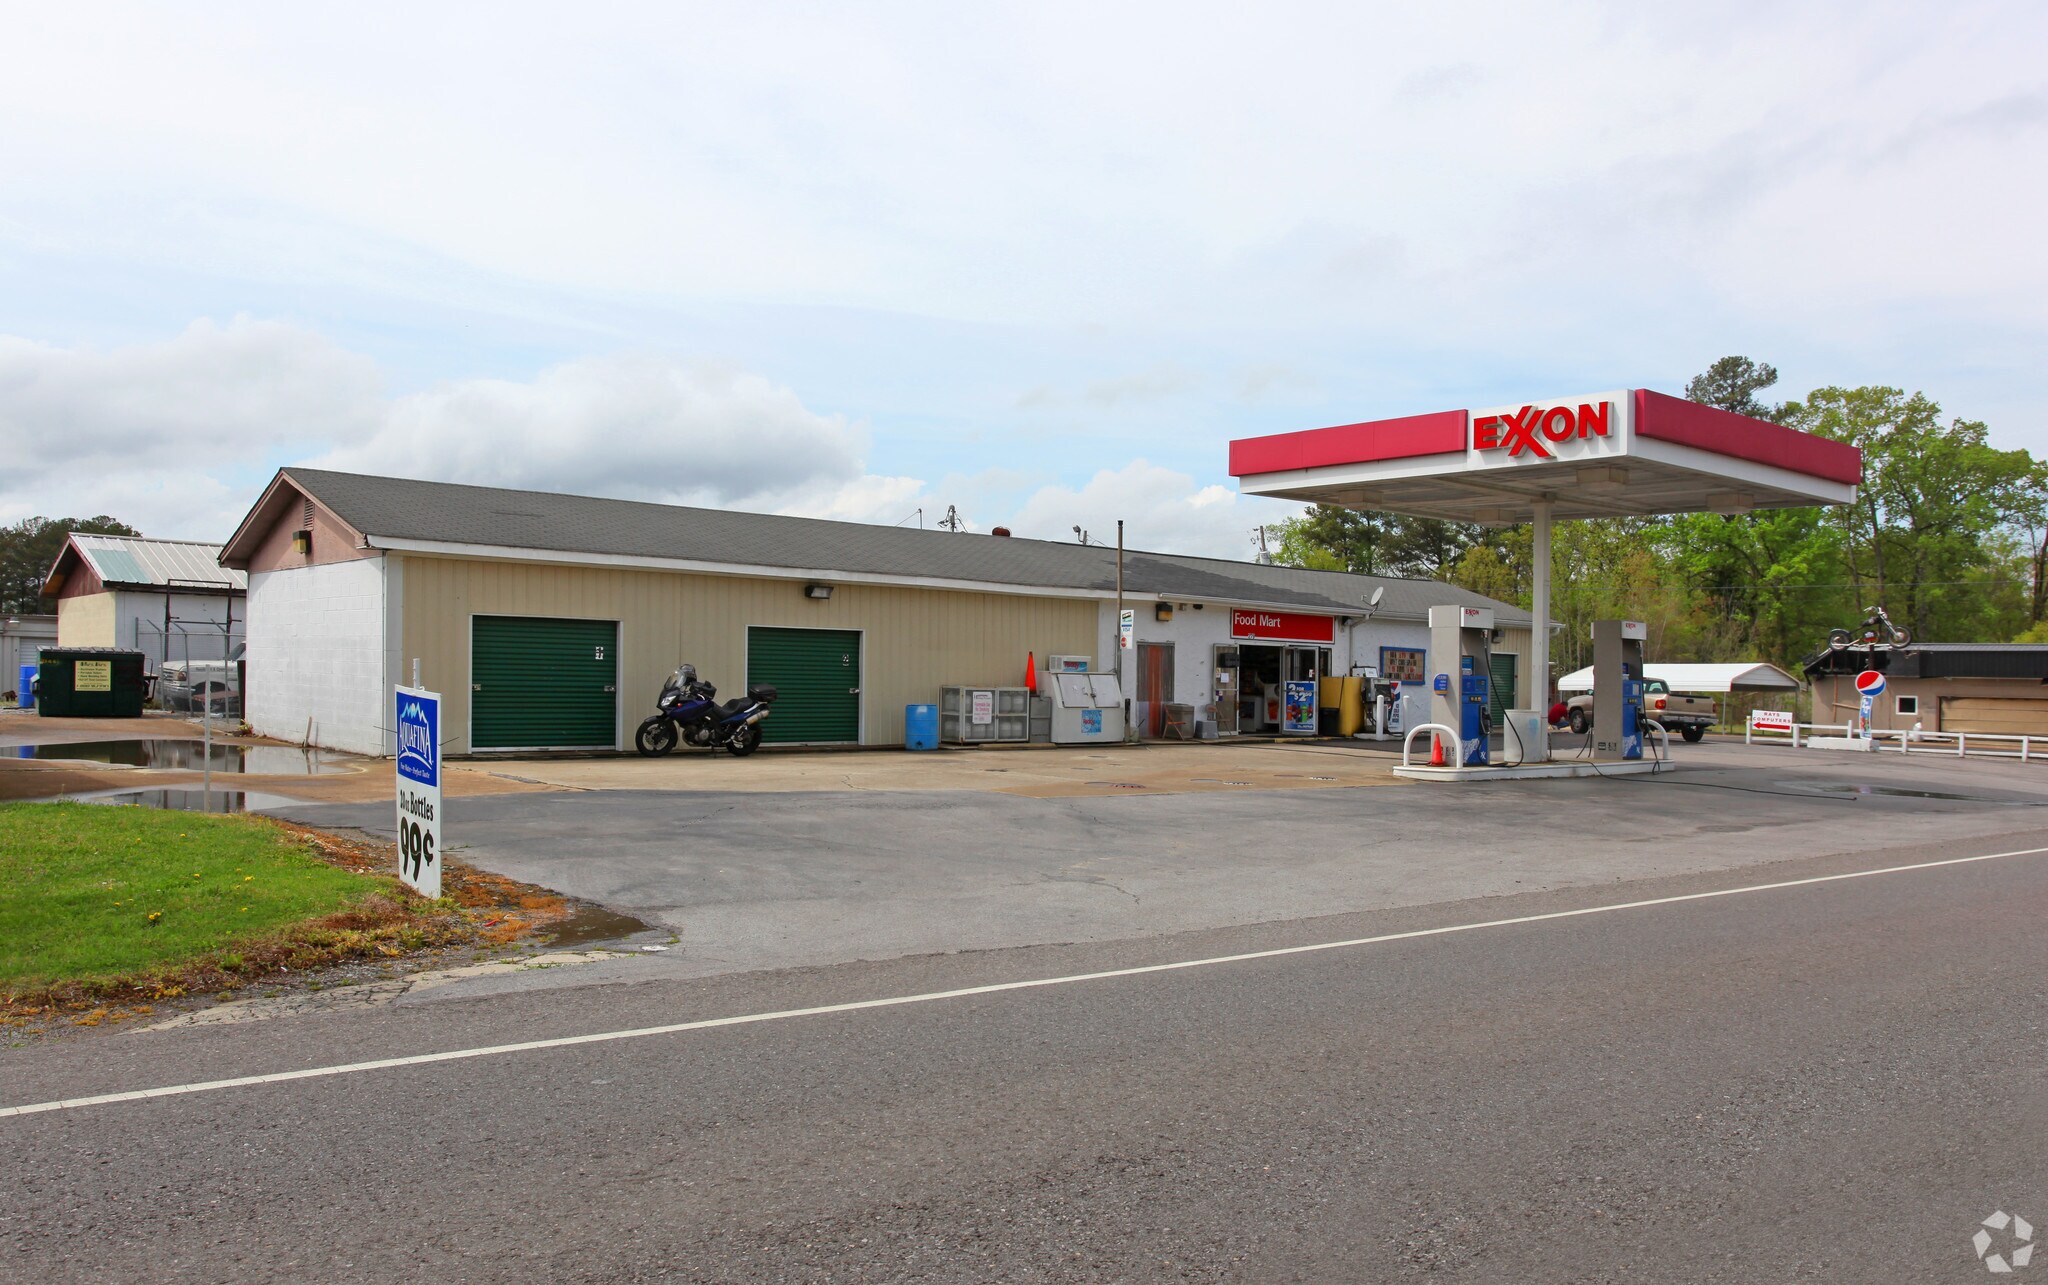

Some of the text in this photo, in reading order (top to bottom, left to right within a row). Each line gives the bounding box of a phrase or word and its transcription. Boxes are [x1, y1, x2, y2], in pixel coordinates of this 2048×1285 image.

[1474, 401, 1611, 458] EXXON
[1234, 612, 1281, 628] Food Mart
[1288, 683, 1297, 695] 2
[398, 714, 433, 766] AQUAFINA
[410, 791, 434, 822] Bottles
[400, 816, 434, 882] 99¢
